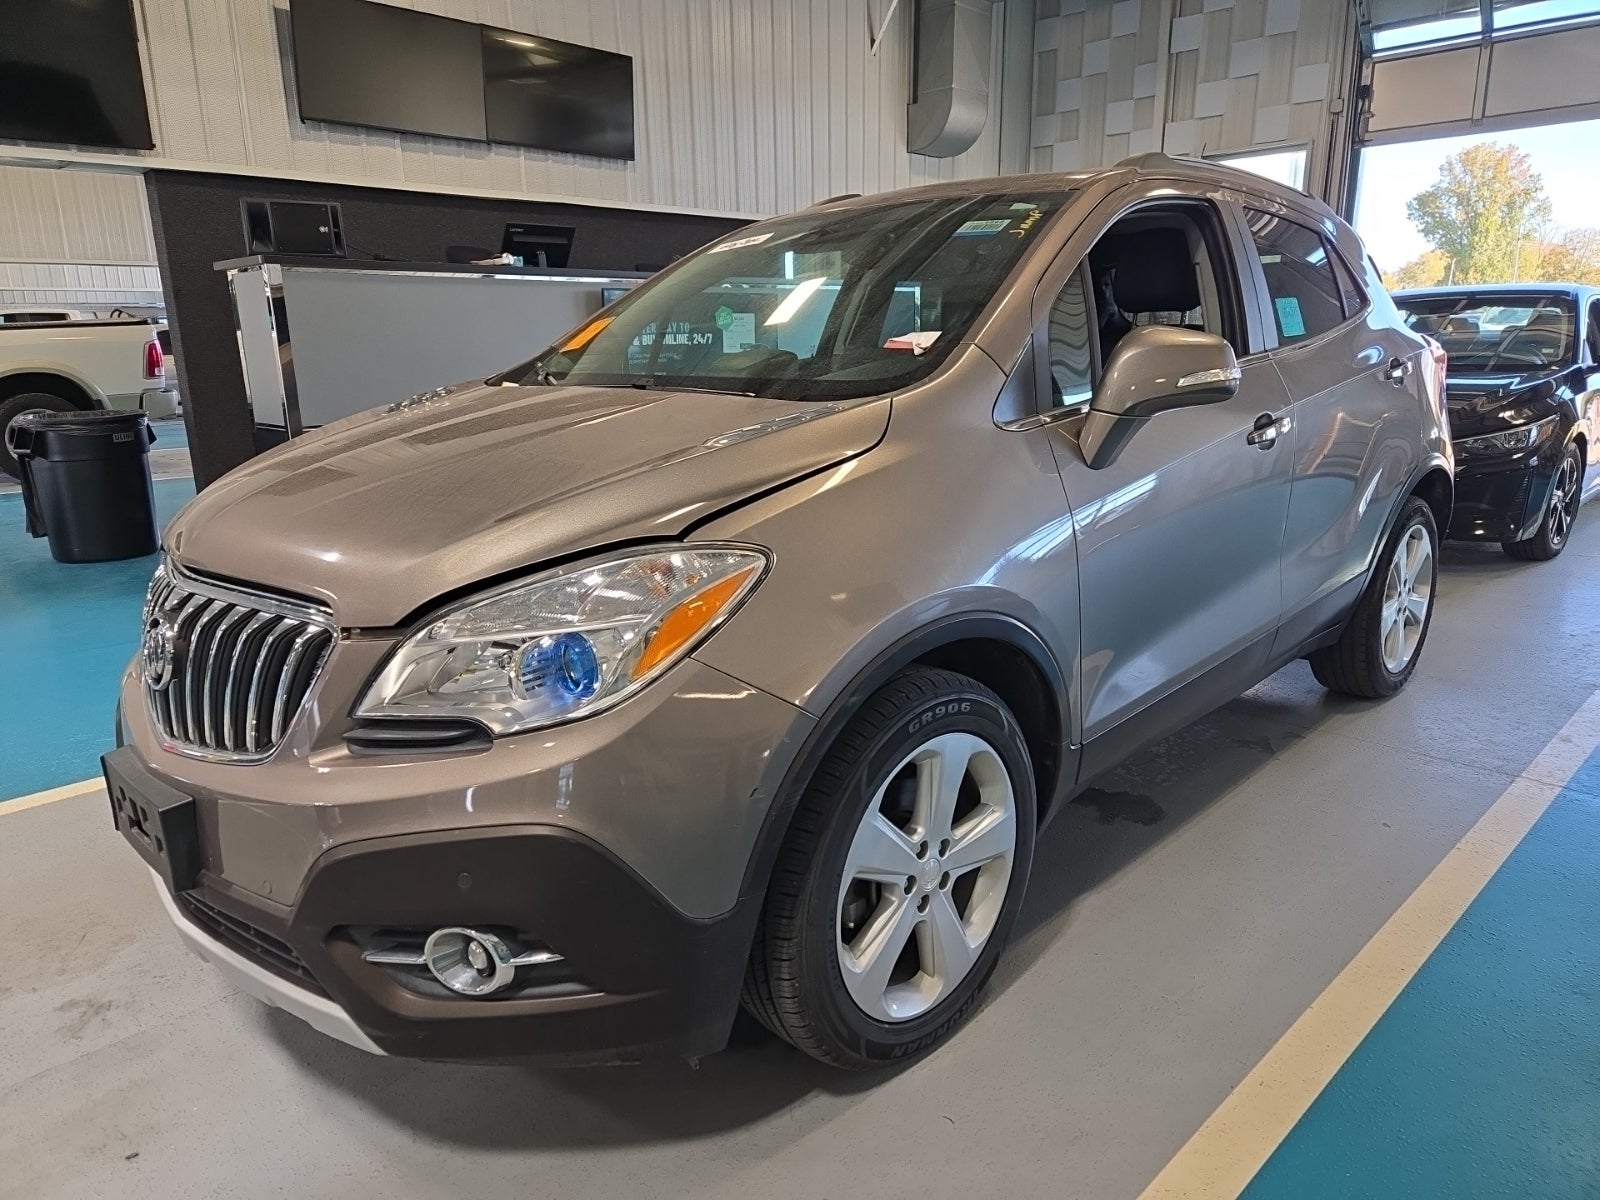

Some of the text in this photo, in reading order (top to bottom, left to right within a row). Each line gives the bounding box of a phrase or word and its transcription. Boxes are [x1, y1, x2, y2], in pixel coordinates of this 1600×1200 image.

[666, 322, 677, 333] AY
[680, 322, 690, 333] TO
[633, 335, 640, 346] &
[693, 333, 713, 345] 24/7
[909, 702, 971, 734] GR906
